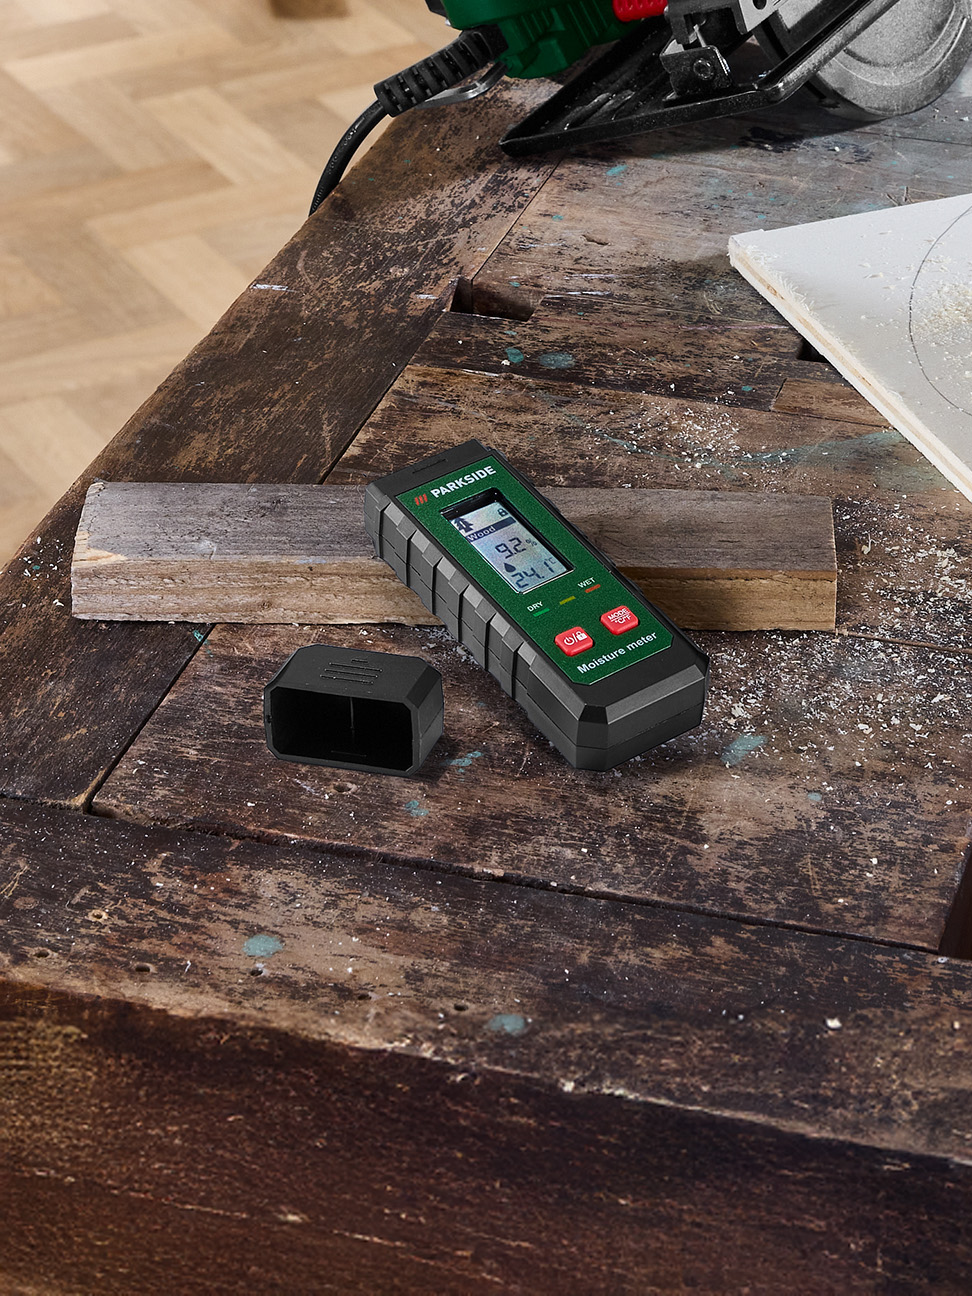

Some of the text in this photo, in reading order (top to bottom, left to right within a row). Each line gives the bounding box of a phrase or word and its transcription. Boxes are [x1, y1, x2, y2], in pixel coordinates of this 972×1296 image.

[430, 466, 496, 498] PARKSIDE
[466, 526, 496, 541] Wood
[577, 576, 597, 589] WET
[527, 601, 544, 612] DRY
[607, 607, 628, 621] MODE
[577, 632, 658, 674] Moisture meter
